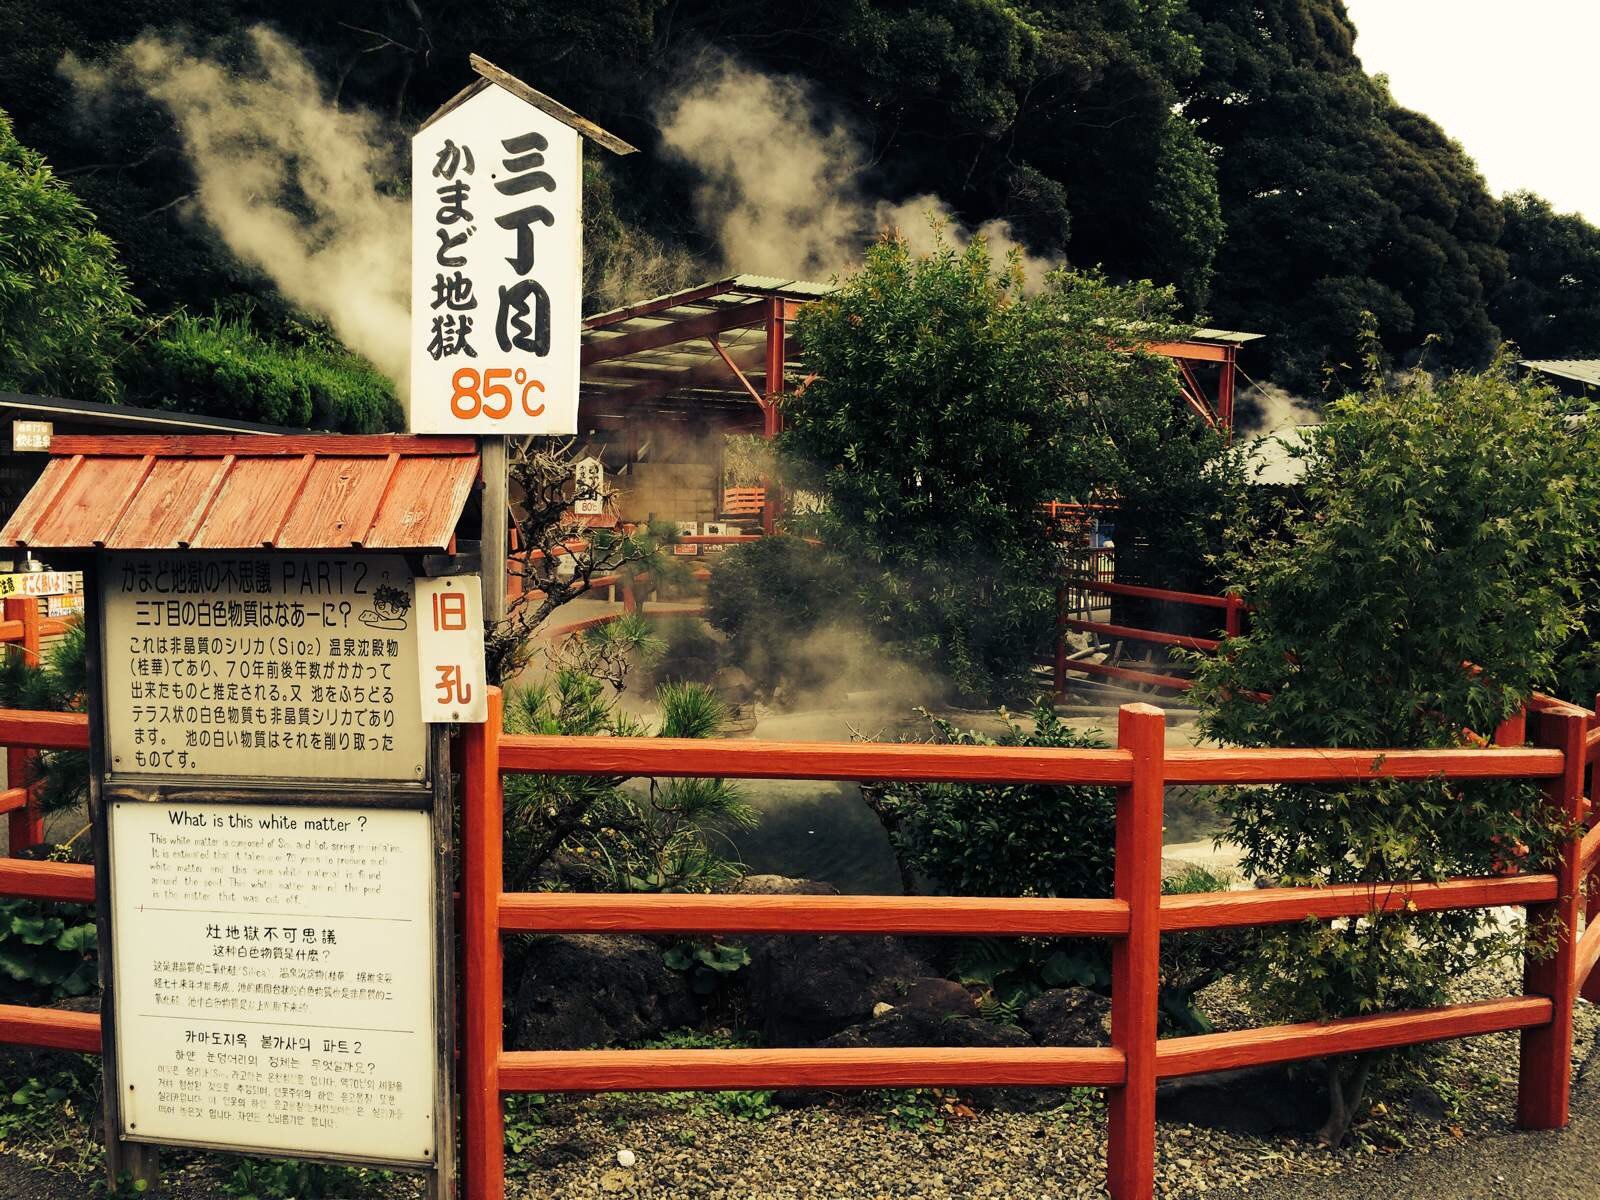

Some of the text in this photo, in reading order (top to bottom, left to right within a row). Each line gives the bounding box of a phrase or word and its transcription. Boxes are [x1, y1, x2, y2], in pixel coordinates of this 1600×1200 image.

[426, 138, 478, 361] かまど地獄
[494, 131, 557, 357] 三丁目
[121, 560, 272, 594] かまど地獄の不思議
[136, 600, 351, 628] 三丁目の白色物質はなあーに？
[135, 750, 196, 769] ものです。
[168, 809, 207, 827] What
[213, 813, 224, 828] is
[228, 812, 253, 829] this
[259, 812, 297, 830] white
[304, 816, 352, 832] matter
[149, 832, 167, 844] This
[170, 835, 191, 845] white
[194, 837, 218, 847] matter
[206, 923, 337, 945] 灶地獄不可思議
[185, 1030, 248, 1049] 카마도지옥
[260, 1034, 311, 1053] 불가사의
[175, 1049, 195, 1062] 하얀
[268, 1056, 300, 1069] 정체는
